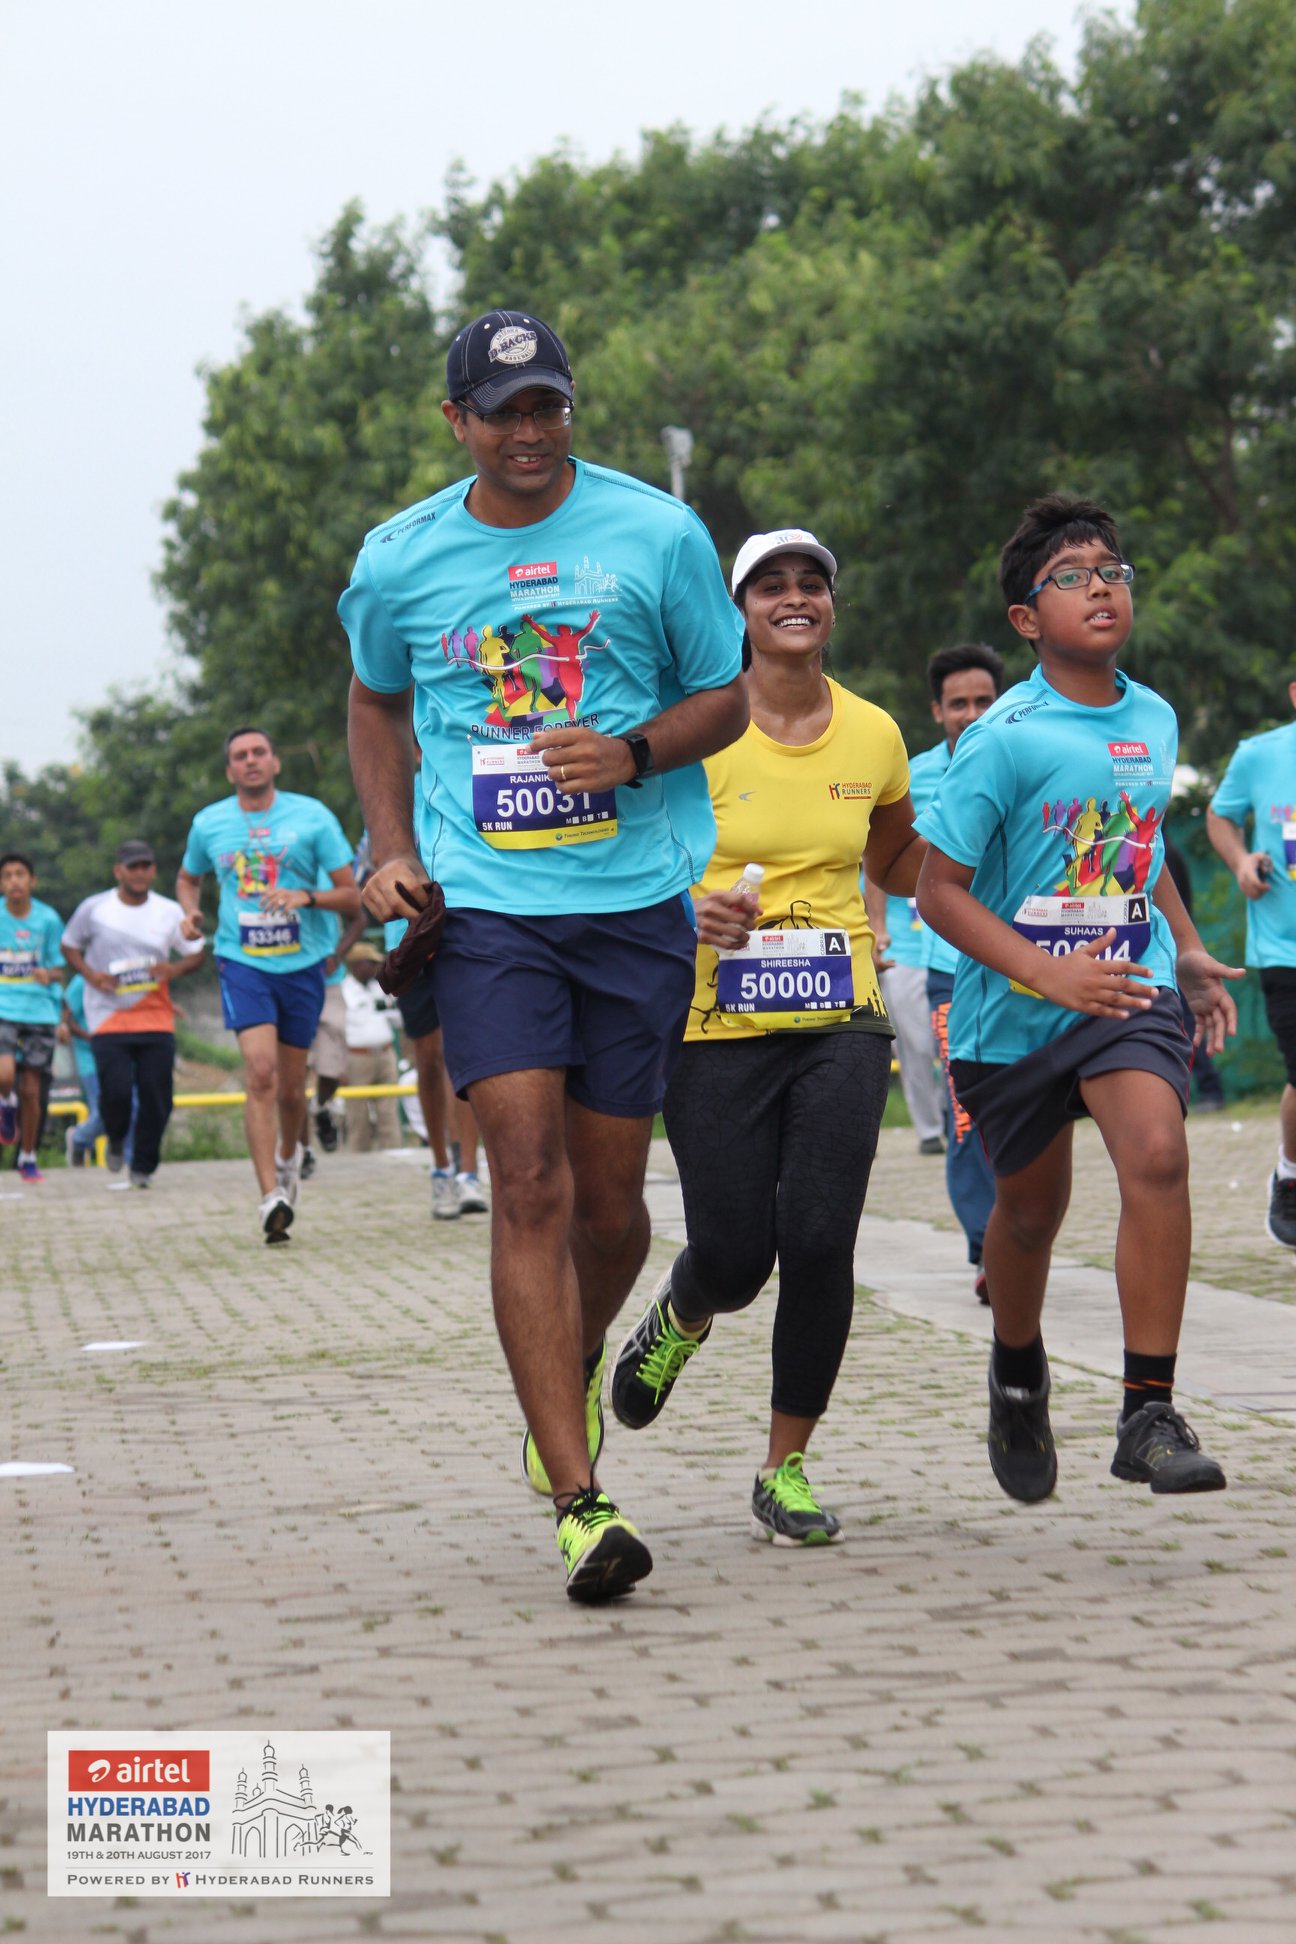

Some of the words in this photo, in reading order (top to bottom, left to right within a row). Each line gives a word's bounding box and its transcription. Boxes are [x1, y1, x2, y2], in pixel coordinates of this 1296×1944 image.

[525, 564, 551, 576] airtel
[509, 576, 559, 590] HYDERABAD
[510, 585, 560, 599] MARATHON
[1121, 744, 1144, 754] airtel
[1112, 756, 1152, 764] HYDERABAD
[1113, 764, 1154, 773] MARATHON
[497, 787, 590, 818] 50031
[482, 822, 494, 831] 5K
[494, 821, 513, 831] RUN
[1131, 902, 1143, 919] A
[1064, 926, 1104, 936] SUHAAS
[828, 936, 842, 952] A
[760, 958, 811, 968] SHIREESHA
[740, 971, 831, 1000] 50000
[725, 1003, 736, 1013] 5K
[737, 1002, 756, 1012] RUN
